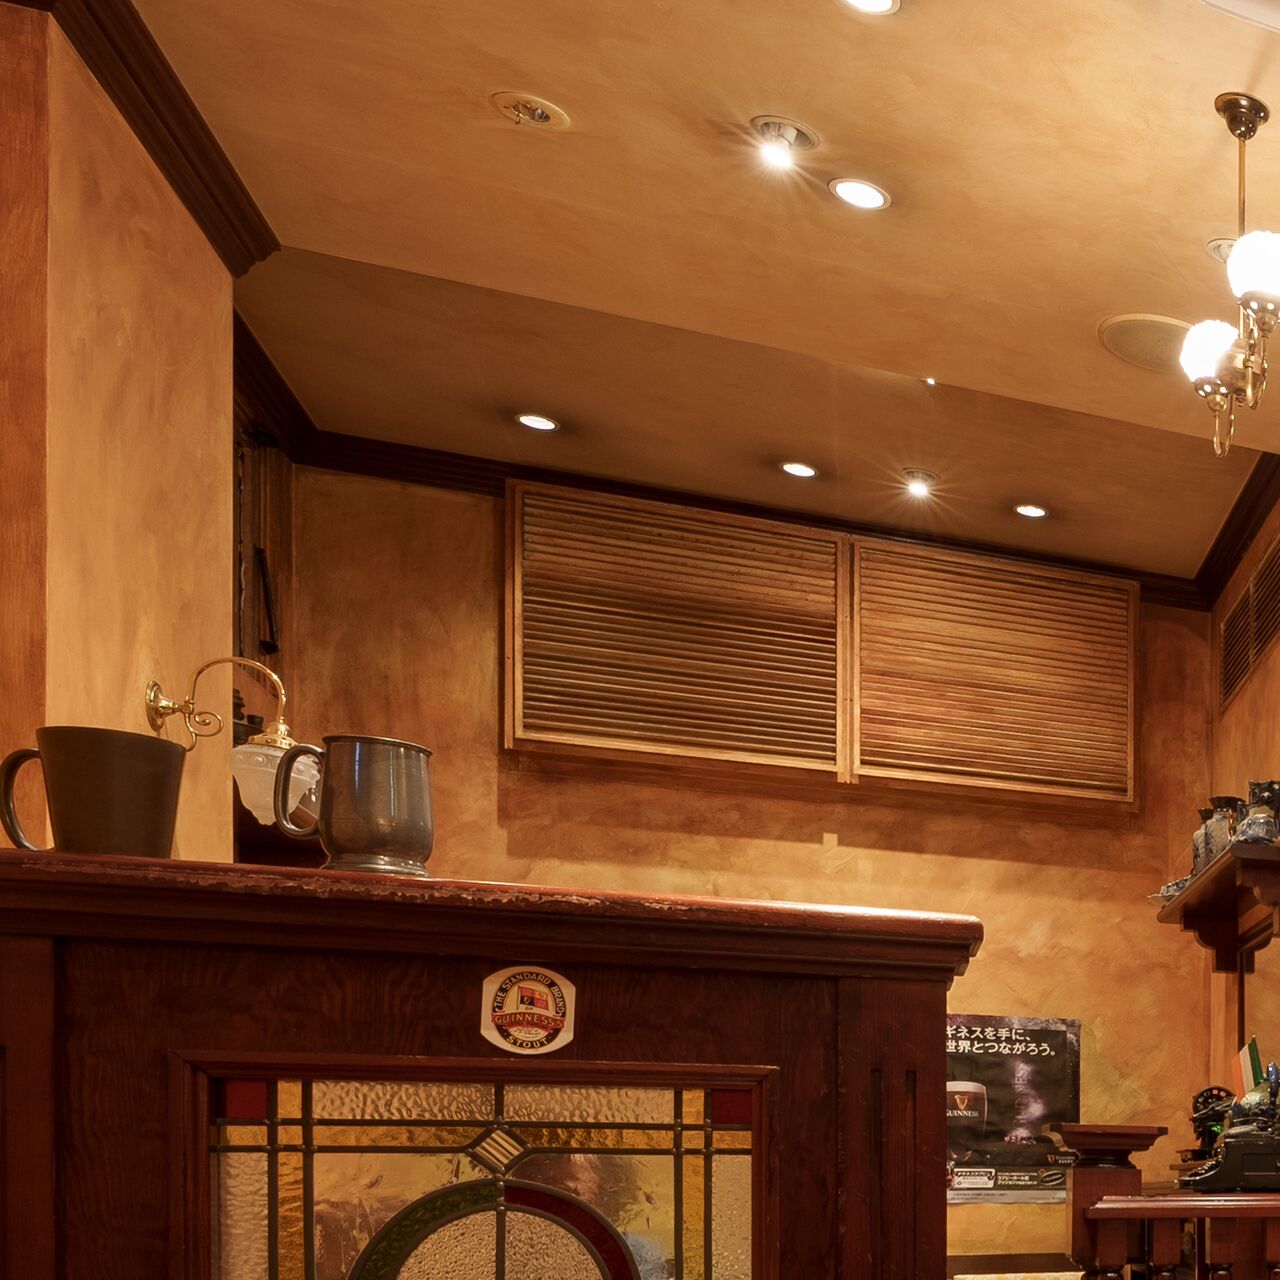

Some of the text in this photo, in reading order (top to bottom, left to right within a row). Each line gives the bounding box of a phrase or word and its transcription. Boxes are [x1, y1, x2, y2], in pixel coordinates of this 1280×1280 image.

[493, 972, 566, 1015] THE STANDARD BRAND
[495, 1013, 563, 1028] GUINNESS'S
[946, 1025, 1032, 1041] ギネスを手に、
[506, 1036, 548, 1049] STOUT
[946, 1040, 1056, 1056] 世界とつながろう。
